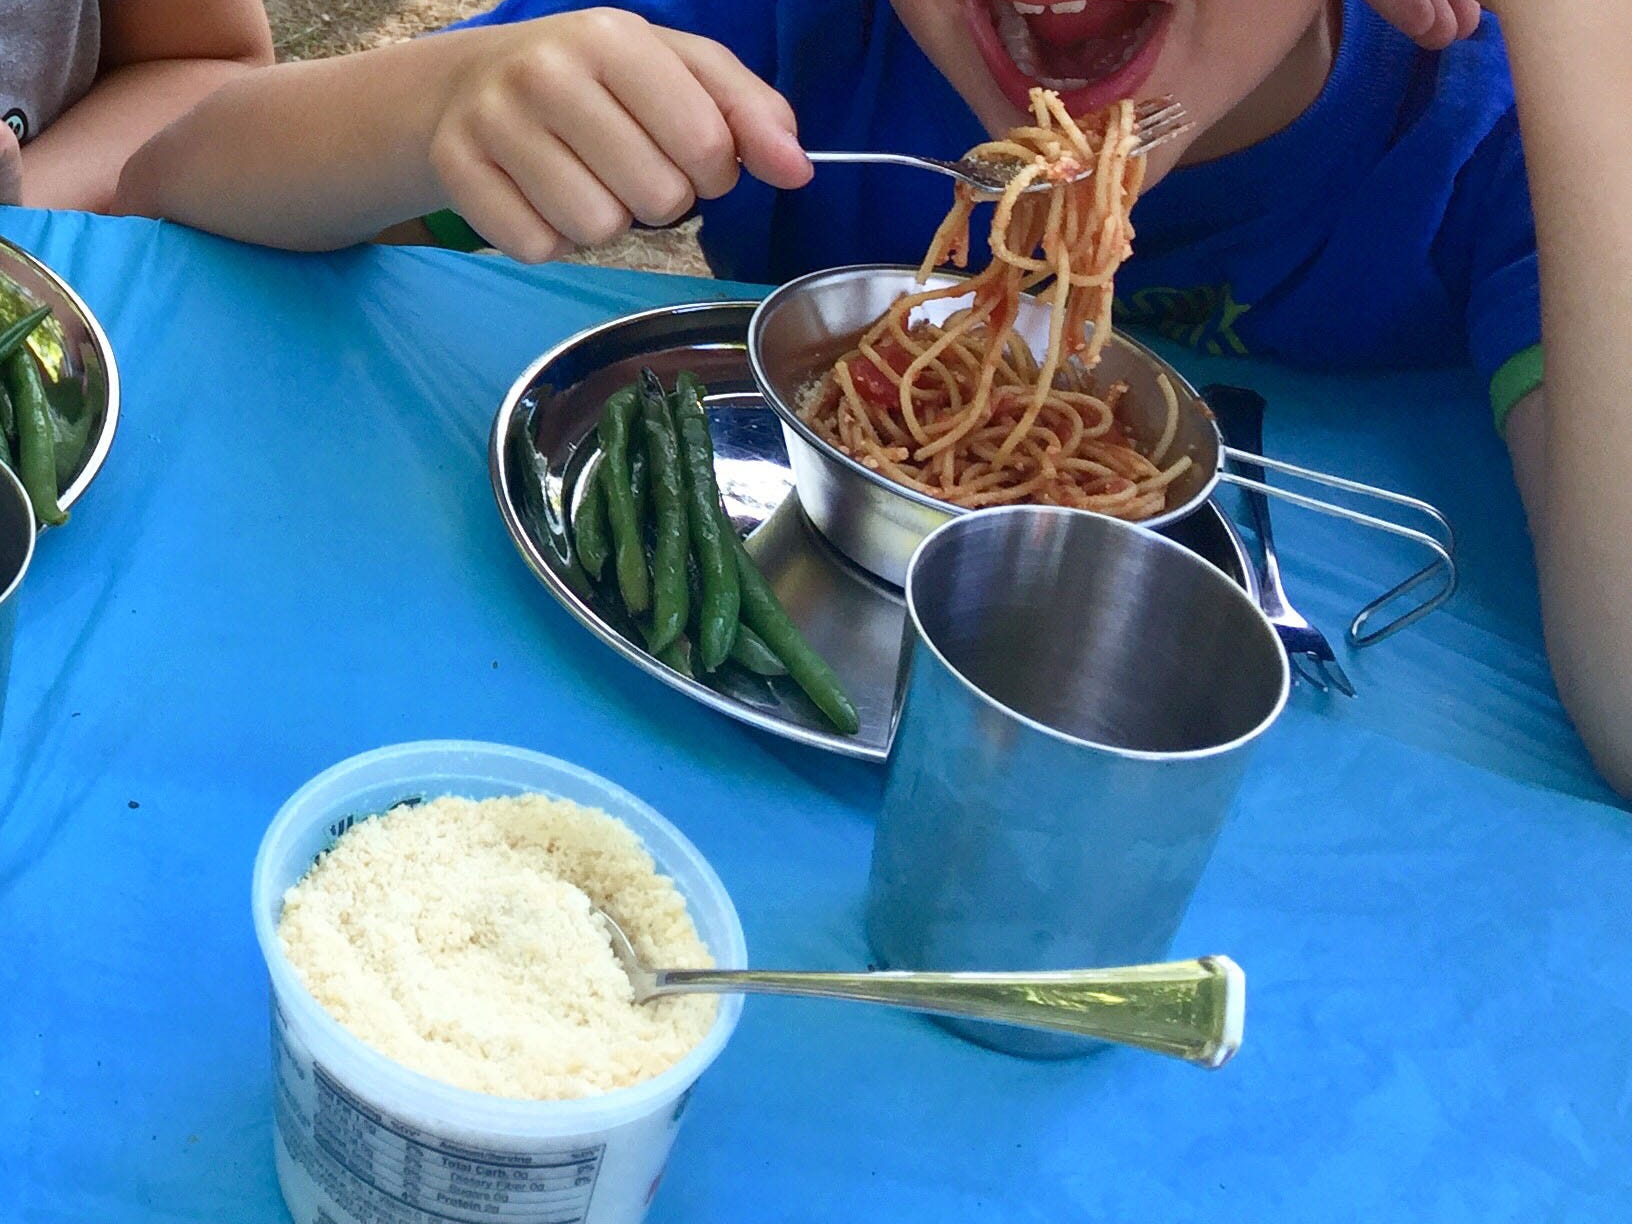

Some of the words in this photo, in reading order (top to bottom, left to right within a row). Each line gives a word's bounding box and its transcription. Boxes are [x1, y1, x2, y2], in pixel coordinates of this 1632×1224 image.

[441, 1157, 471, 1173] Total
[512, 1170, 529, 1181] 0g
[450, 1172, 493, 1189] Dietary
[496, 1181, 527, 1192] Fiber
[436, 1192, 482, 1212] Protein
